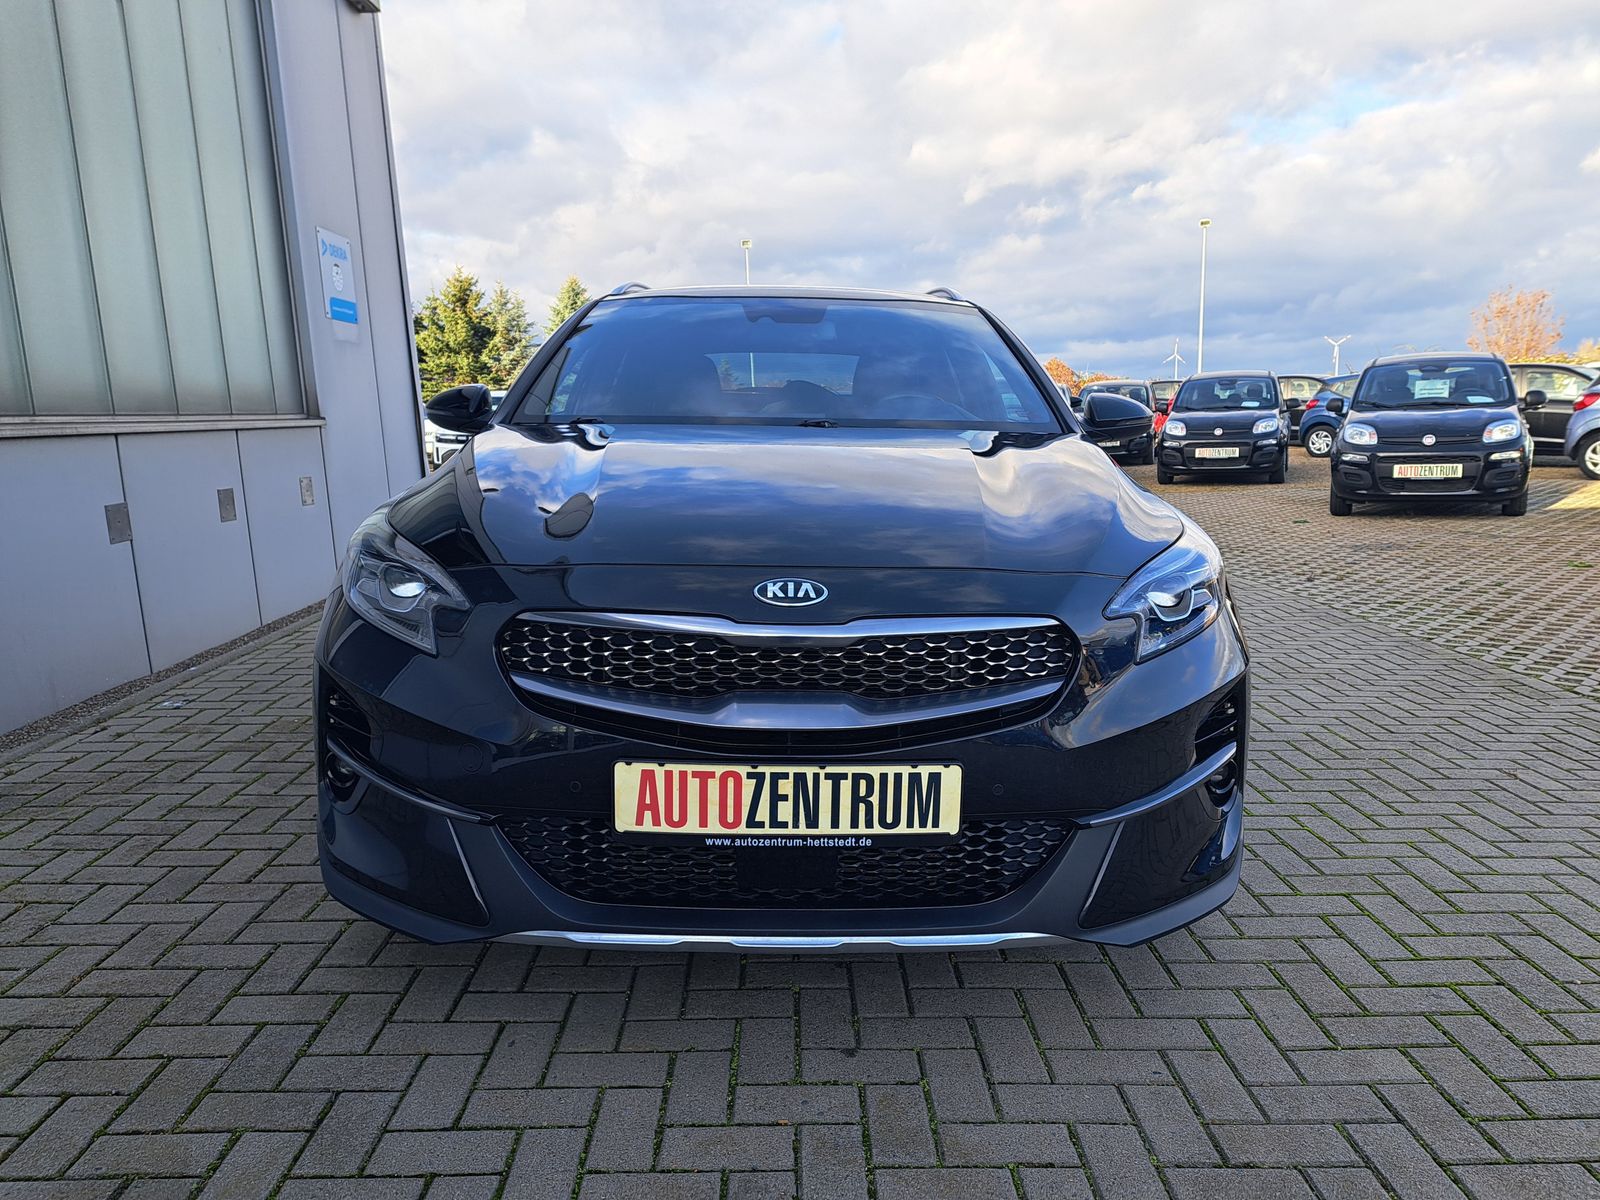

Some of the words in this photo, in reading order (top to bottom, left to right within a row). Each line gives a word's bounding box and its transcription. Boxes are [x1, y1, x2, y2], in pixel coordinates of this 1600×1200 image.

[1397, 465, 1459, 477] AUTOZENTRUM
[766, 581, 817, 599] KIA
[634, 768, 943, 830] AUTOZENTRUM
[705, 837, 872, 847] www.autozentrum-hettstedt.de
